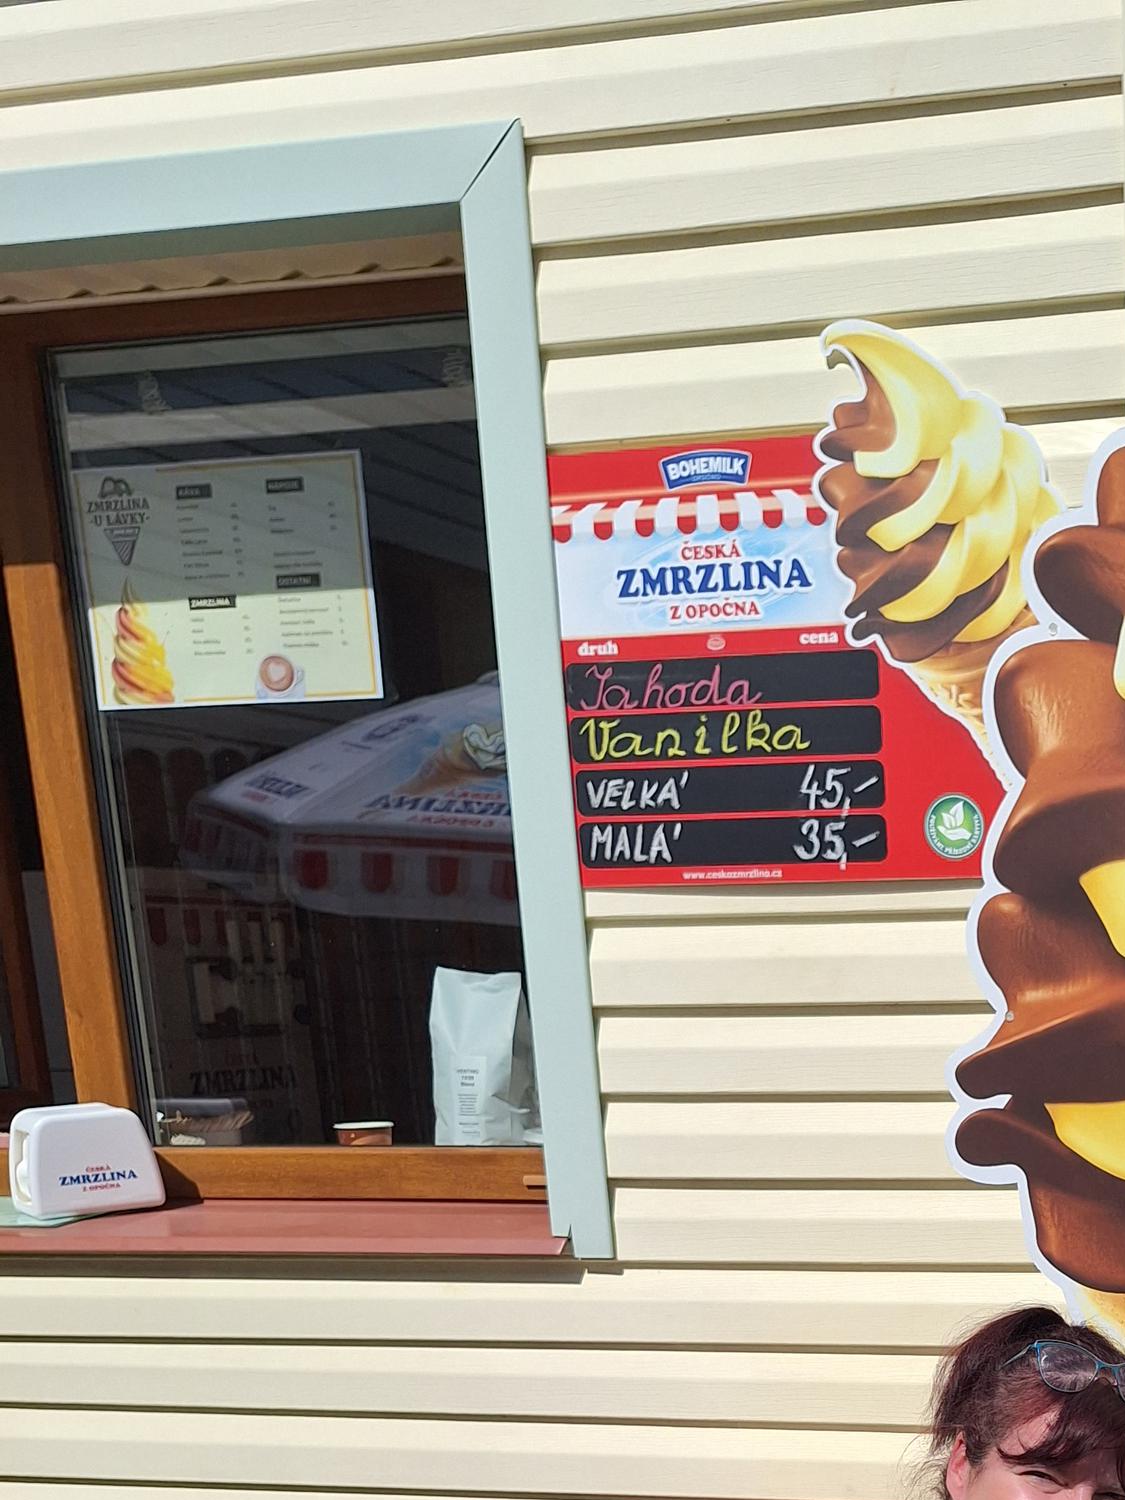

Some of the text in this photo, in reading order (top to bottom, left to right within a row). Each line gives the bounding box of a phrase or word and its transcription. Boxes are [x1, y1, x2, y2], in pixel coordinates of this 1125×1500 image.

[666, 456, 745, 480] BOHEMILK
[87, 497, 150, 513] ZMRZLINA
[681, 540, 741, 560] ČESKÁ
[617, 558, 812, 598] ZMRZLINA
[670, 598, 760, 619] Z OPOČNA
[577, 640, 619, 656] druh
[799, 631, 839, 645] cena
[579, 709, 811, 761] Vanilka
[59, 1169, 138, 1186] ZMRZLINA
